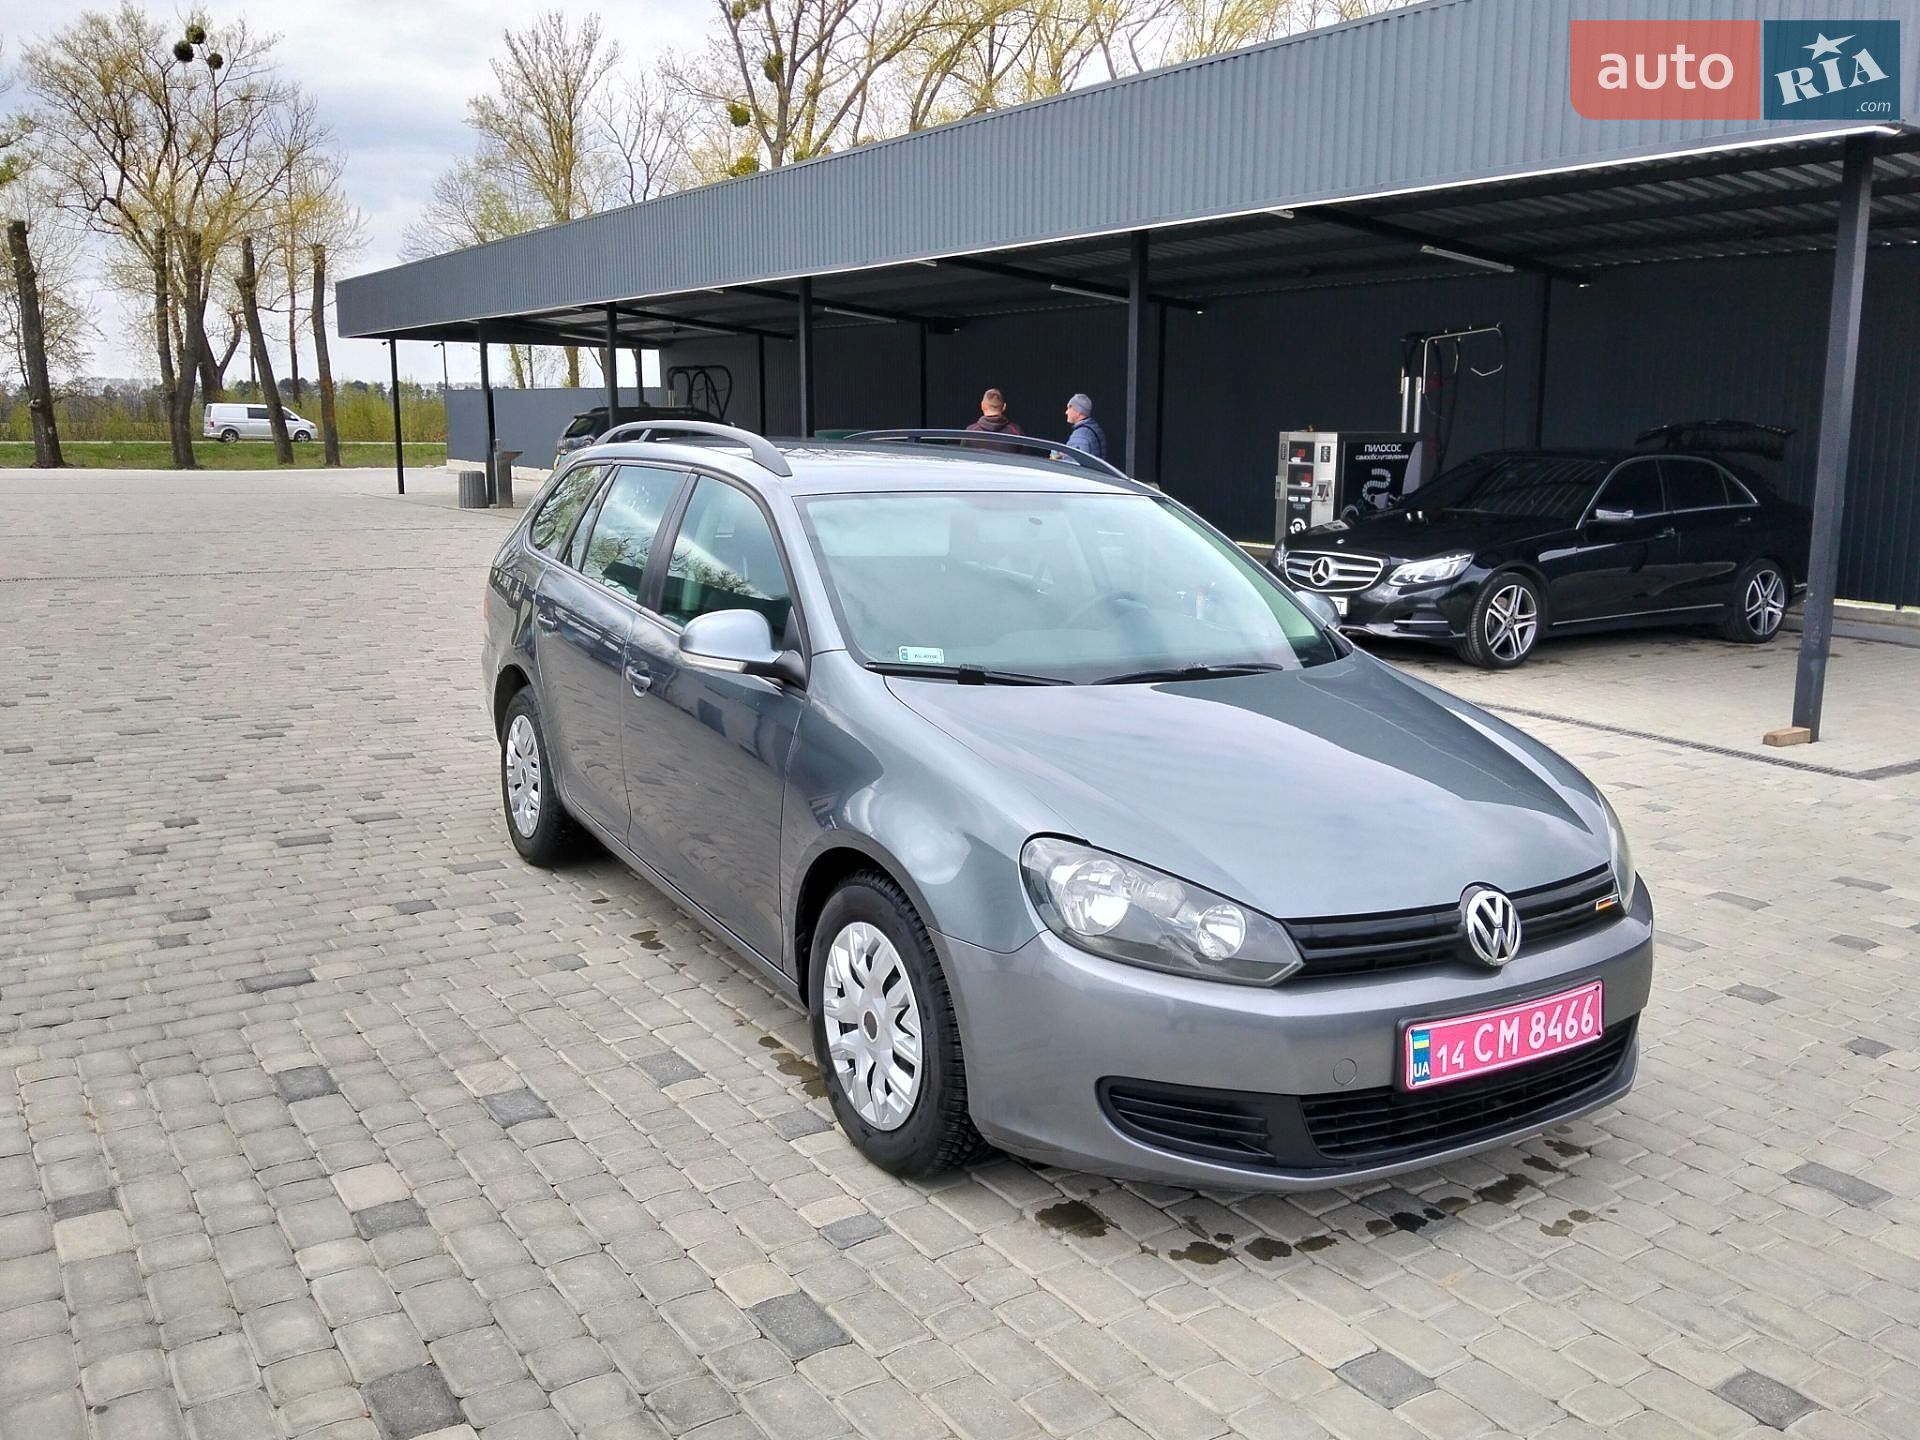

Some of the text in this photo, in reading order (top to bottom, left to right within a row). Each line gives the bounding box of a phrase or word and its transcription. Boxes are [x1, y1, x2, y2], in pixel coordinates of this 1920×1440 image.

[1364, 444, 1402, 452] ПИЛОСОС
[1436, 995, 1594, 1073] 14 CM 8466
[1413, 1061, 1430, 1077] UA
